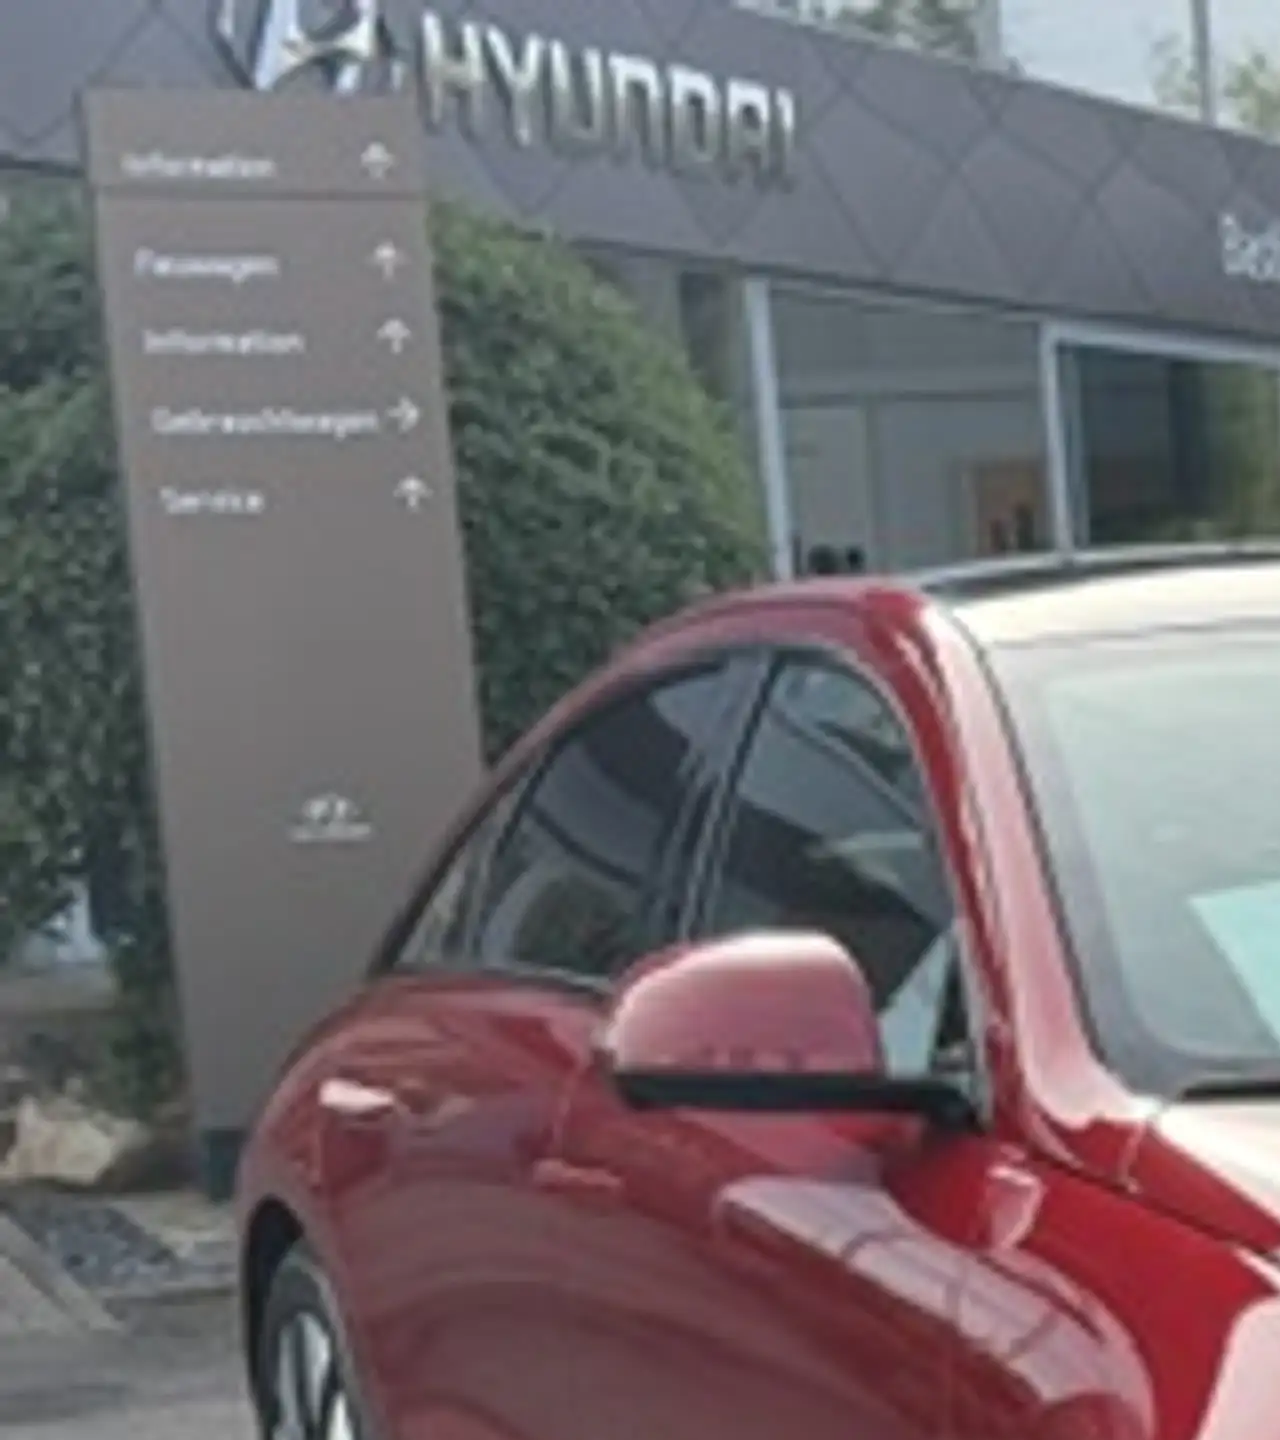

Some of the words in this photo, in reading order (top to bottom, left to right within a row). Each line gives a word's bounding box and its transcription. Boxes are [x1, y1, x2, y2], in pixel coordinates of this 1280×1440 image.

[420, 10, 796, 178] HYUNDAI
[121, 151, 277, 178] Information
[143, 328, 305, 355] Information
[159, 485, 265, 514] Service
